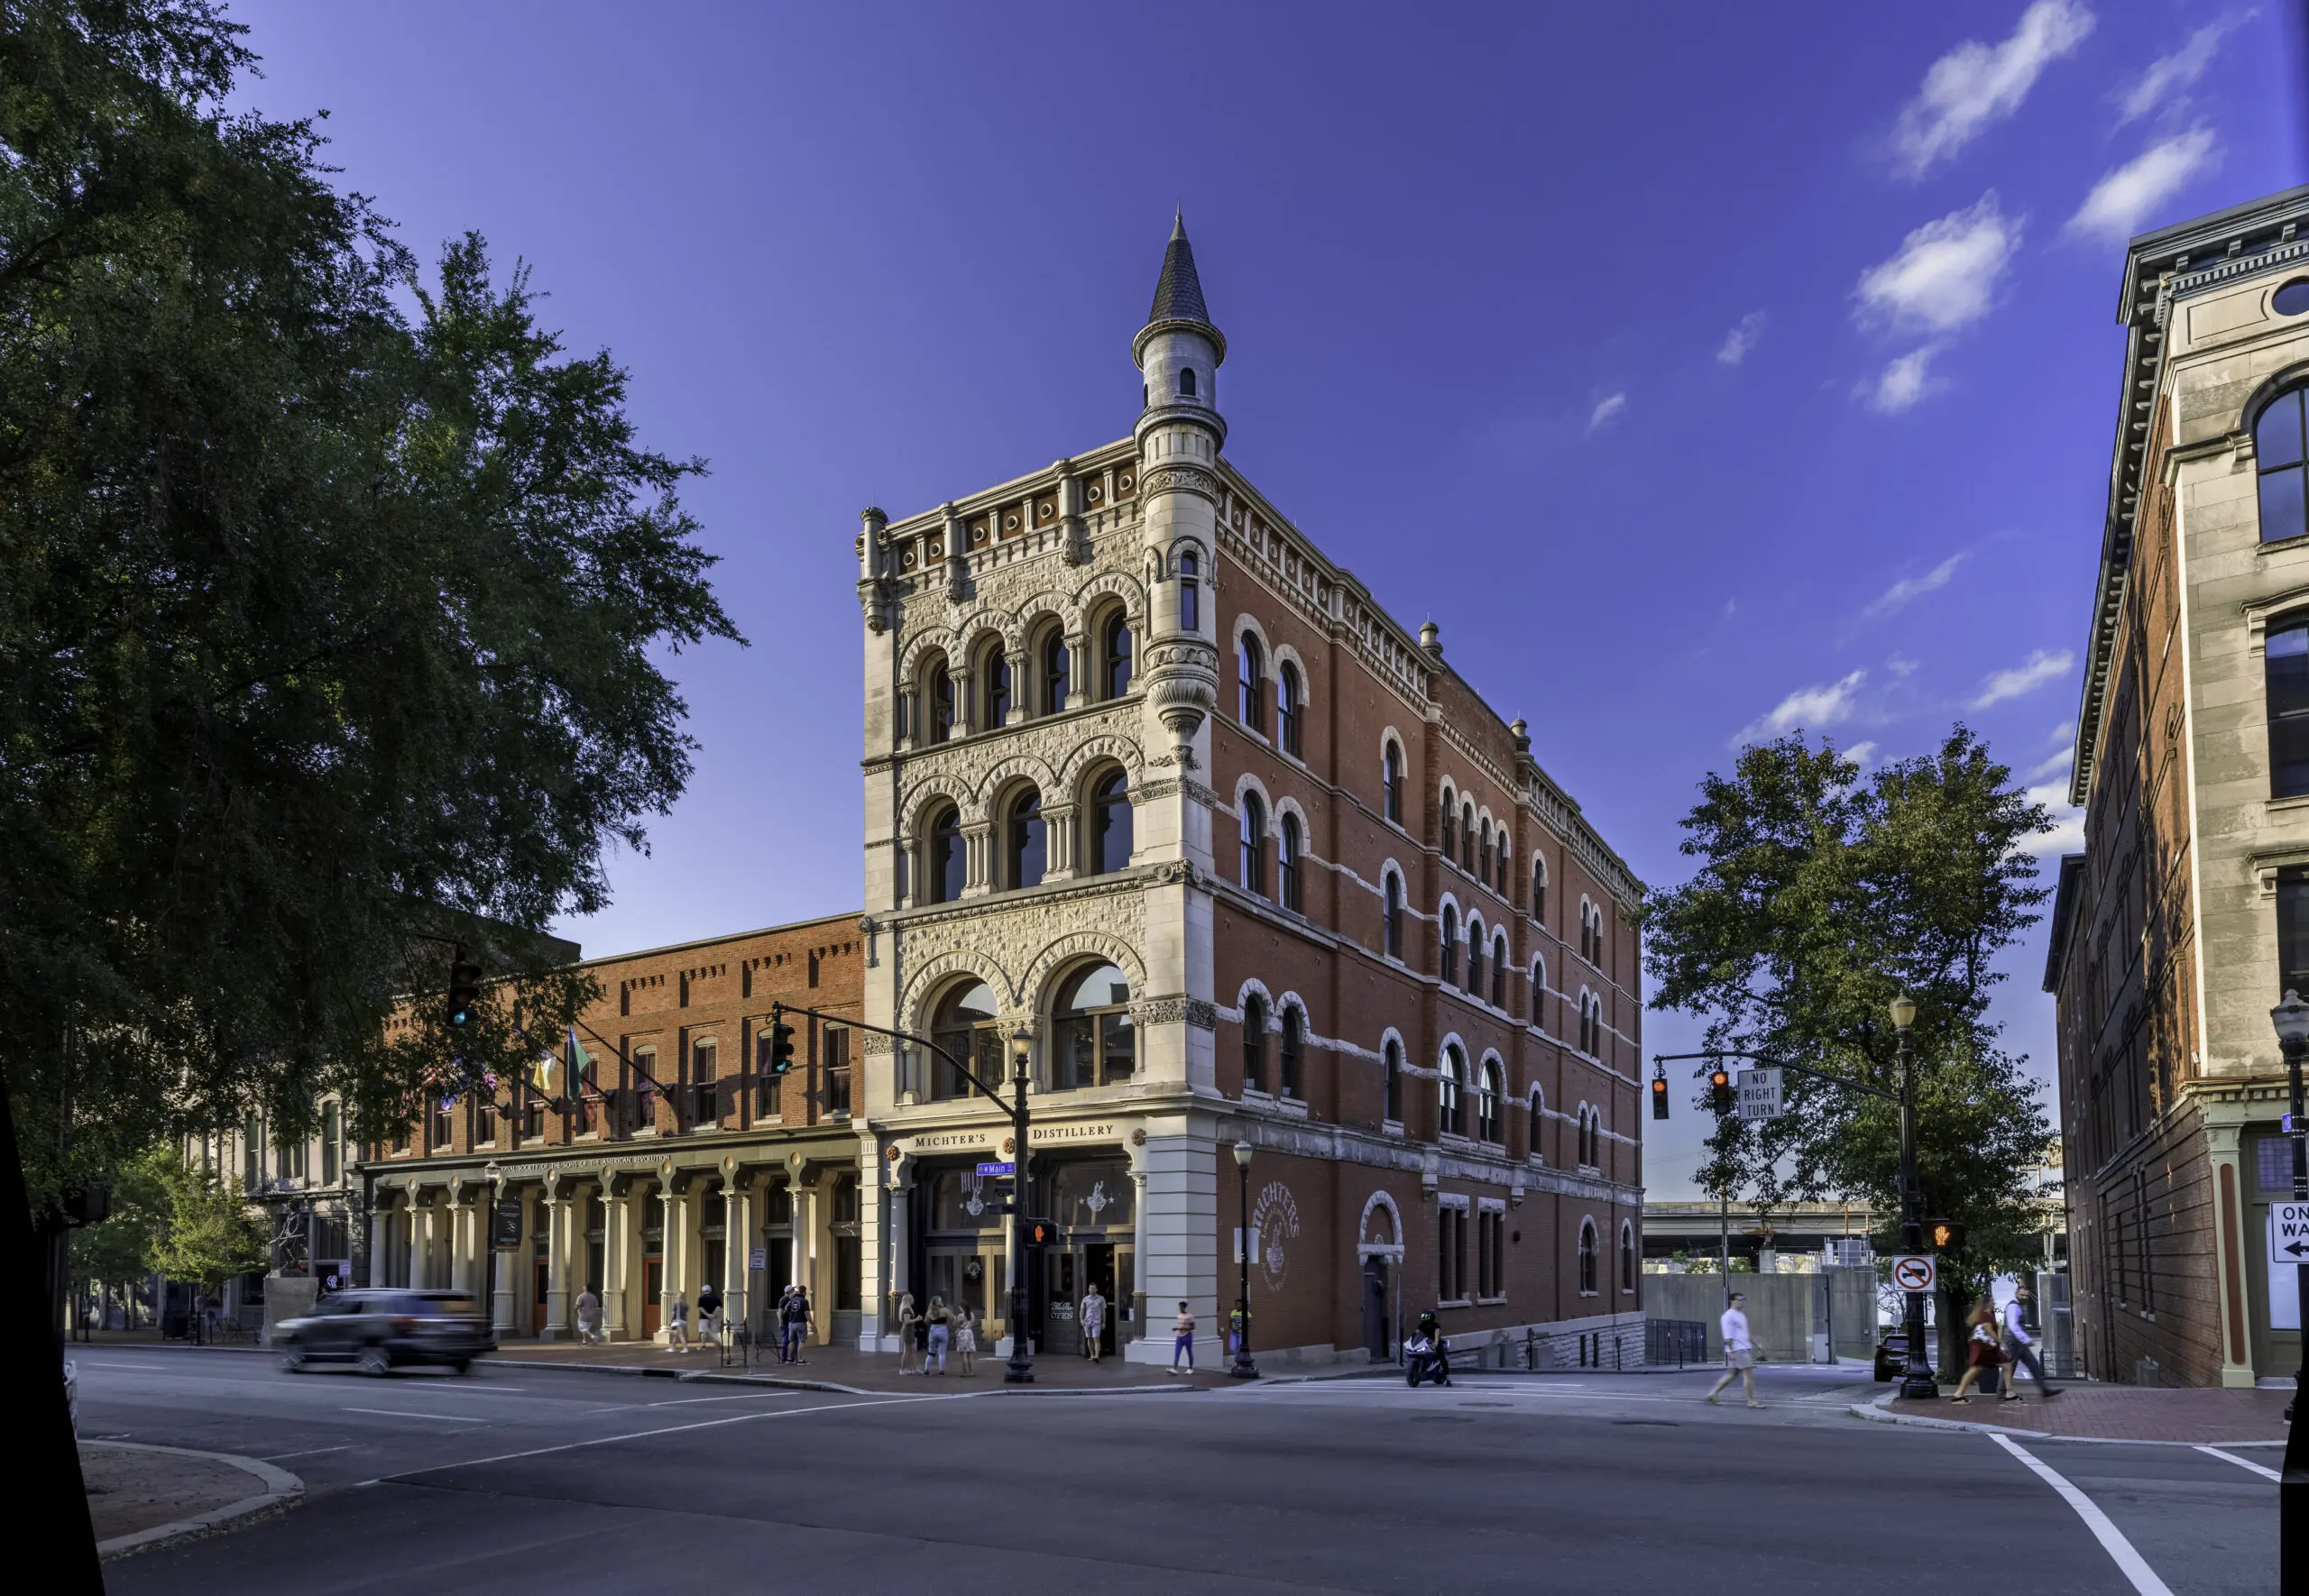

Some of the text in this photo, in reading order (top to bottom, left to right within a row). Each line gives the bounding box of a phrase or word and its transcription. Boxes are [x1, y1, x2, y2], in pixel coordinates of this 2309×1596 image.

[1752, 1073, 1766, 1084] NO
[1744, 1087, 1775, 1101] RIGHT
[1747, 1104, 1774, 1116] TURN
[915, 1125, 1114, 1147] MICHTER'S DISTILLERY
[518, 1163, 539, 1171] SOCIETY
[563, 1160, 577, 1169] SONS
[603, 1157, 631, 1165] AMERICAN
[633, 1154, 670, 1163] REVOLUTION
[989, 1164, 1006, 1174] Main
